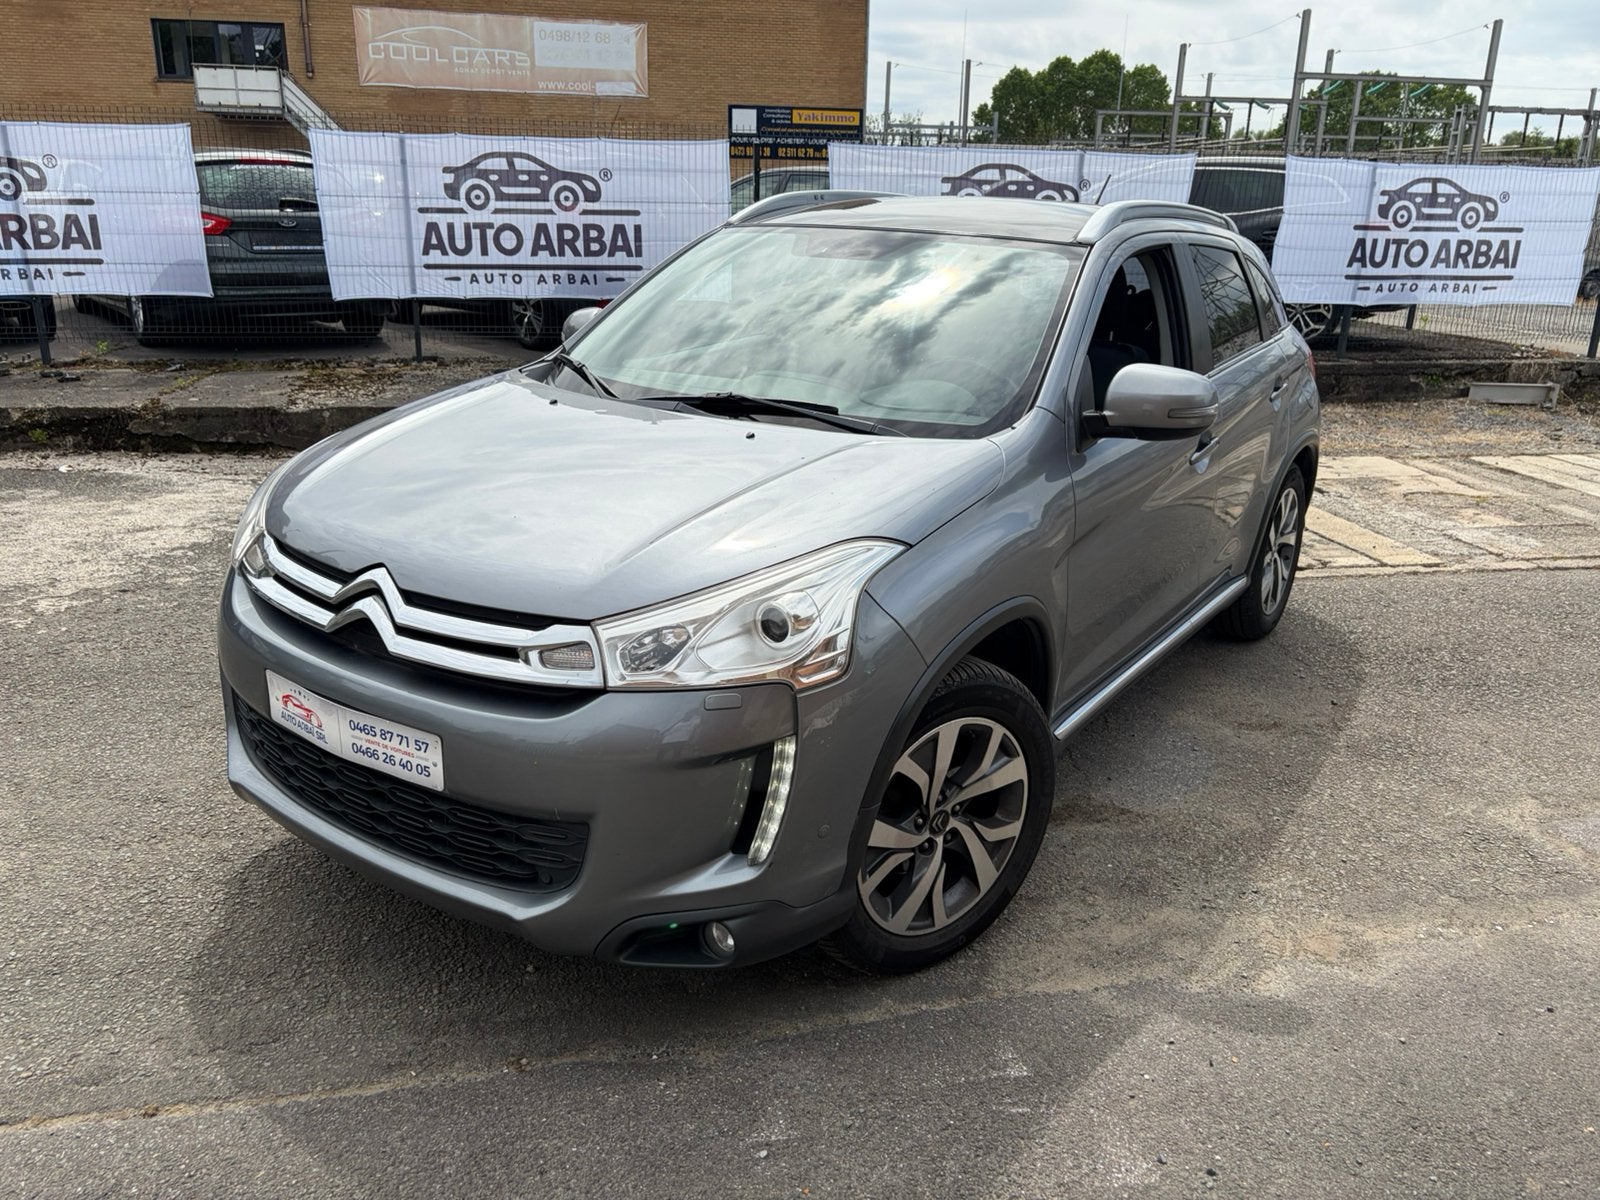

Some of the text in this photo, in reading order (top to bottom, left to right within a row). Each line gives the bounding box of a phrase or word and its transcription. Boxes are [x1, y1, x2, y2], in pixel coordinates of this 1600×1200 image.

[797, 111, 855, 123] Yakimmo
[0, 213, 102, 250] RBAI
[422, 221, 643, 258] AUTO ARBAI
[1346, 237, 1522, 270] AUTO ARBAI
[469, 272, 598, 286] AUTO ARBAI
[1375, 283, 1477, 295] AUTO ARBAI
[281, 710, 297, 727] AUTO
[348, 719, 429, 754] 0465 87 71 57
[364, 738, 415, 759] VENTE DE VOITURES
[351, 742, 431, 778] 0466 26 40 05
